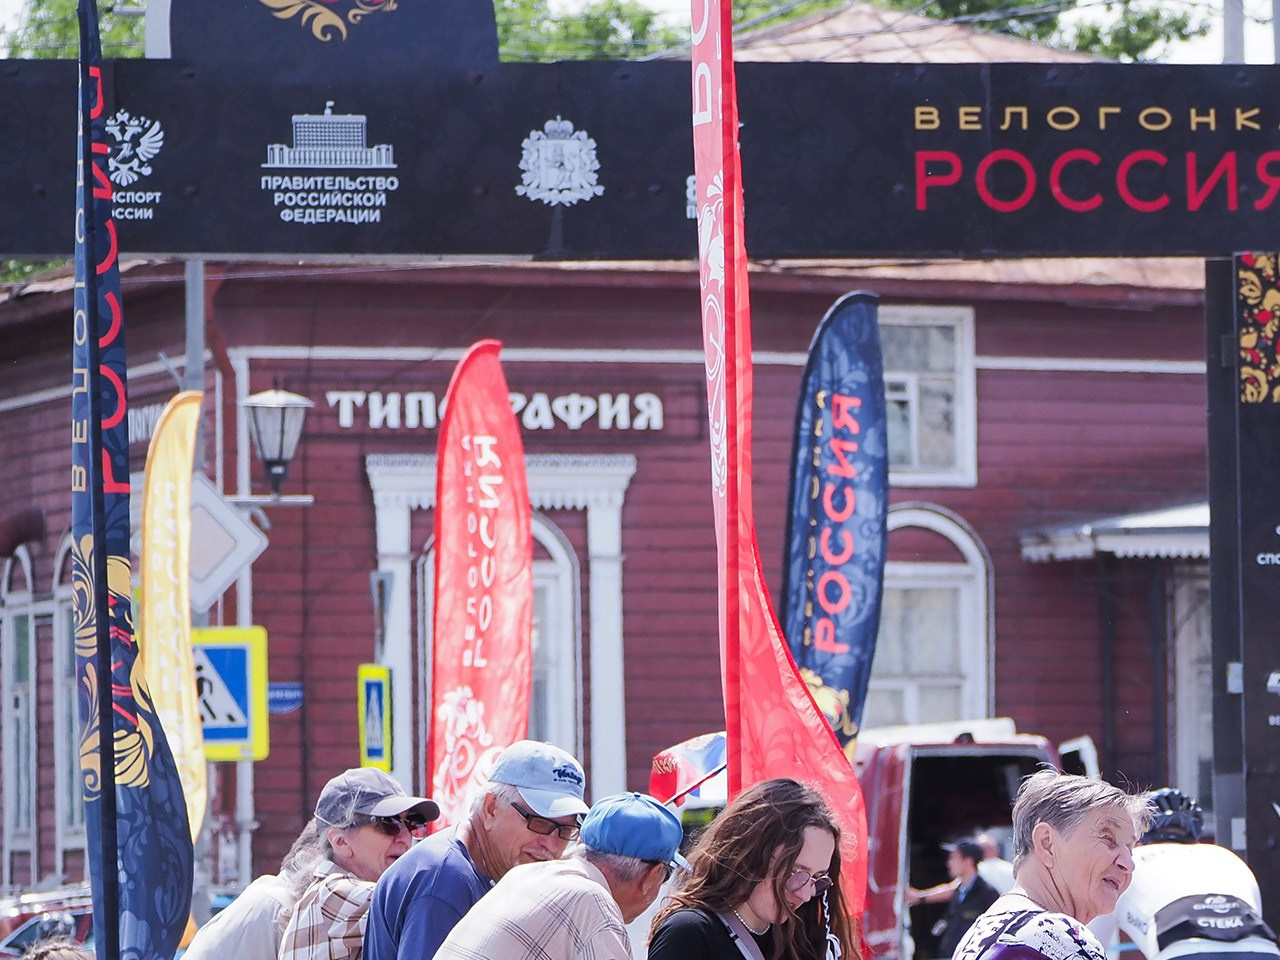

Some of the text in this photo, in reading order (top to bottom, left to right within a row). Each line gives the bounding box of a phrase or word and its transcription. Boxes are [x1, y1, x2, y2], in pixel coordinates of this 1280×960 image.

[261, 176, 399, 190] ПРАВИТЕЛЬСТВО
[274, 191, 387, 206] РОССИЙСКОЙ
[280, 209, 381, 224] ФЕДЕРАЦИИ
[814, 393, 862, 654] РОССИЯ
